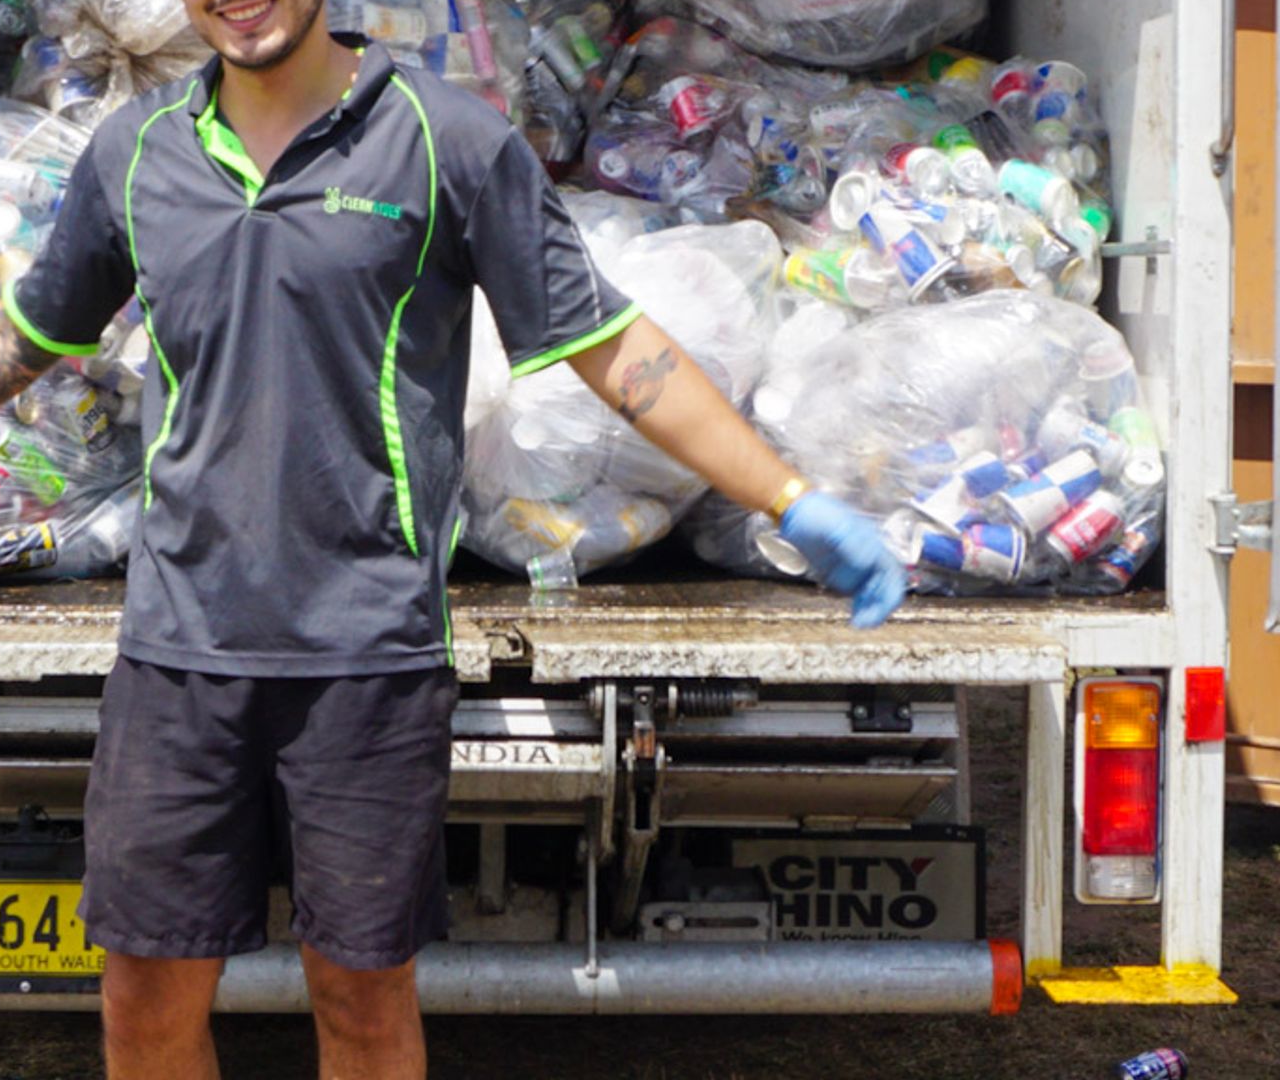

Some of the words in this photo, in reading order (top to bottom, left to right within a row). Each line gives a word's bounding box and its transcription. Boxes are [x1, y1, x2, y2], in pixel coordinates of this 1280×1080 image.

[451, 744, 553, 764] NDIA
[770, 855, 935, 891] CITY
[774, 893, 938, 929] HINO
[59, 954, 107, 970] WALE
